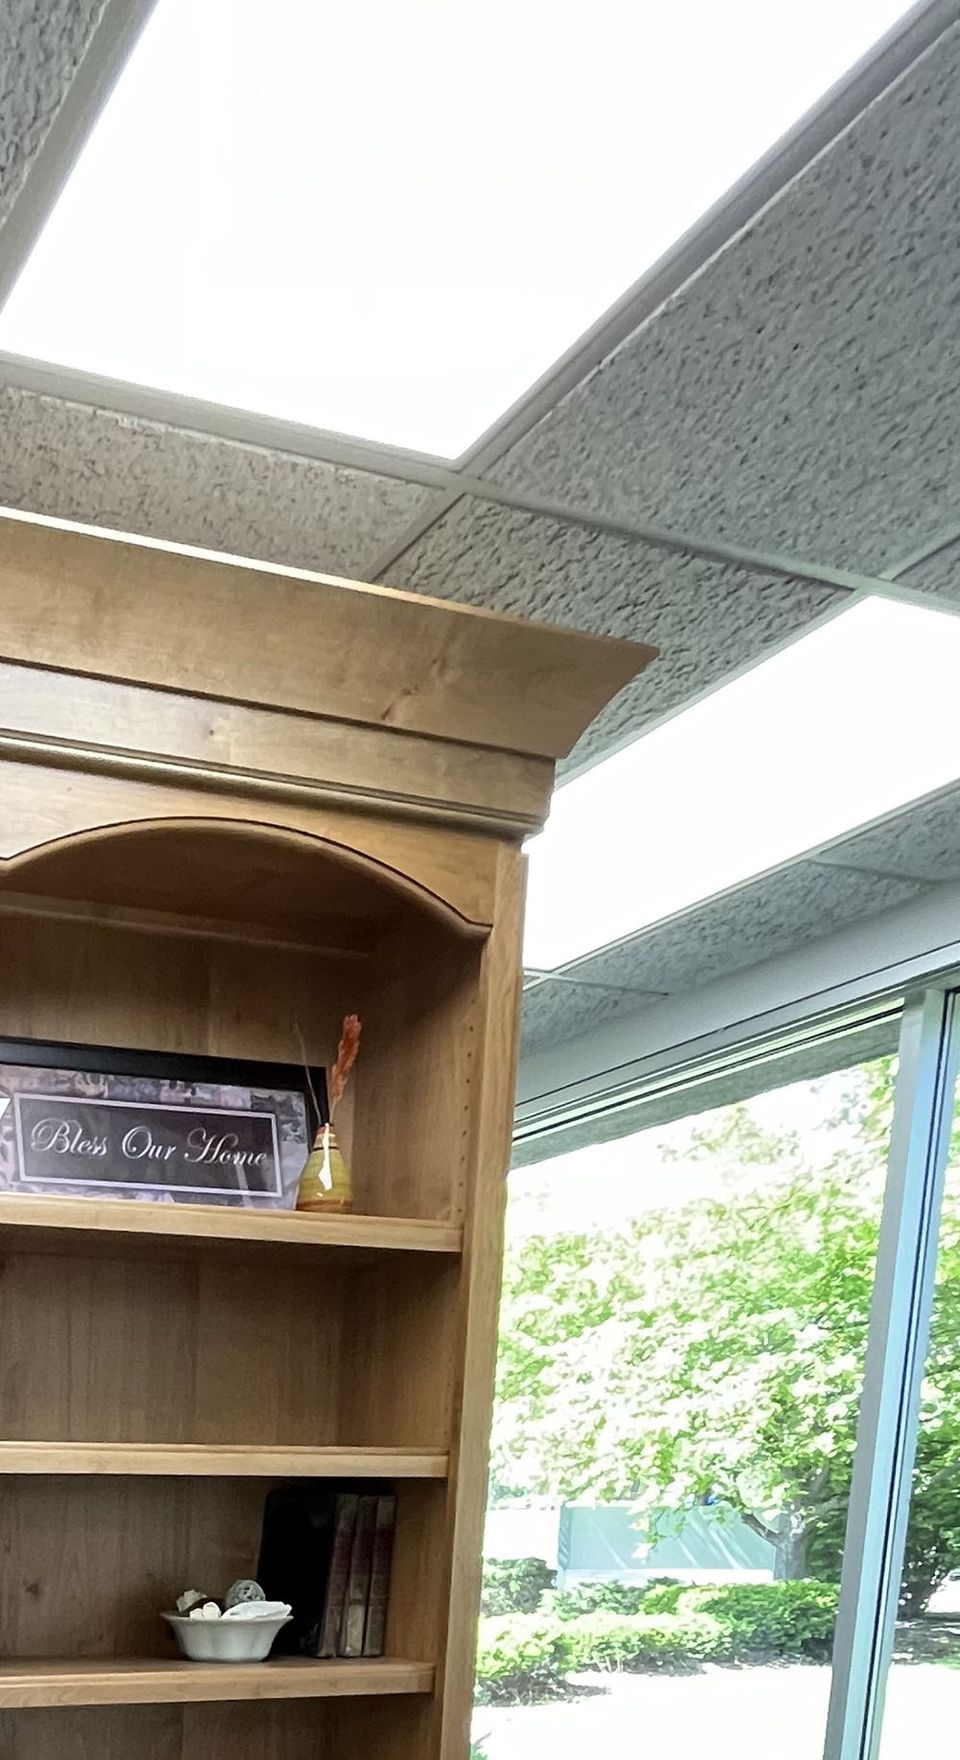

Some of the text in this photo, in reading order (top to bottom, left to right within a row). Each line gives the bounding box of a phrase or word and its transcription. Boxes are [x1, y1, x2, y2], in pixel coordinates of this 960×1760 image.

[31, 1117, 268, 1167] Bless Our Home
